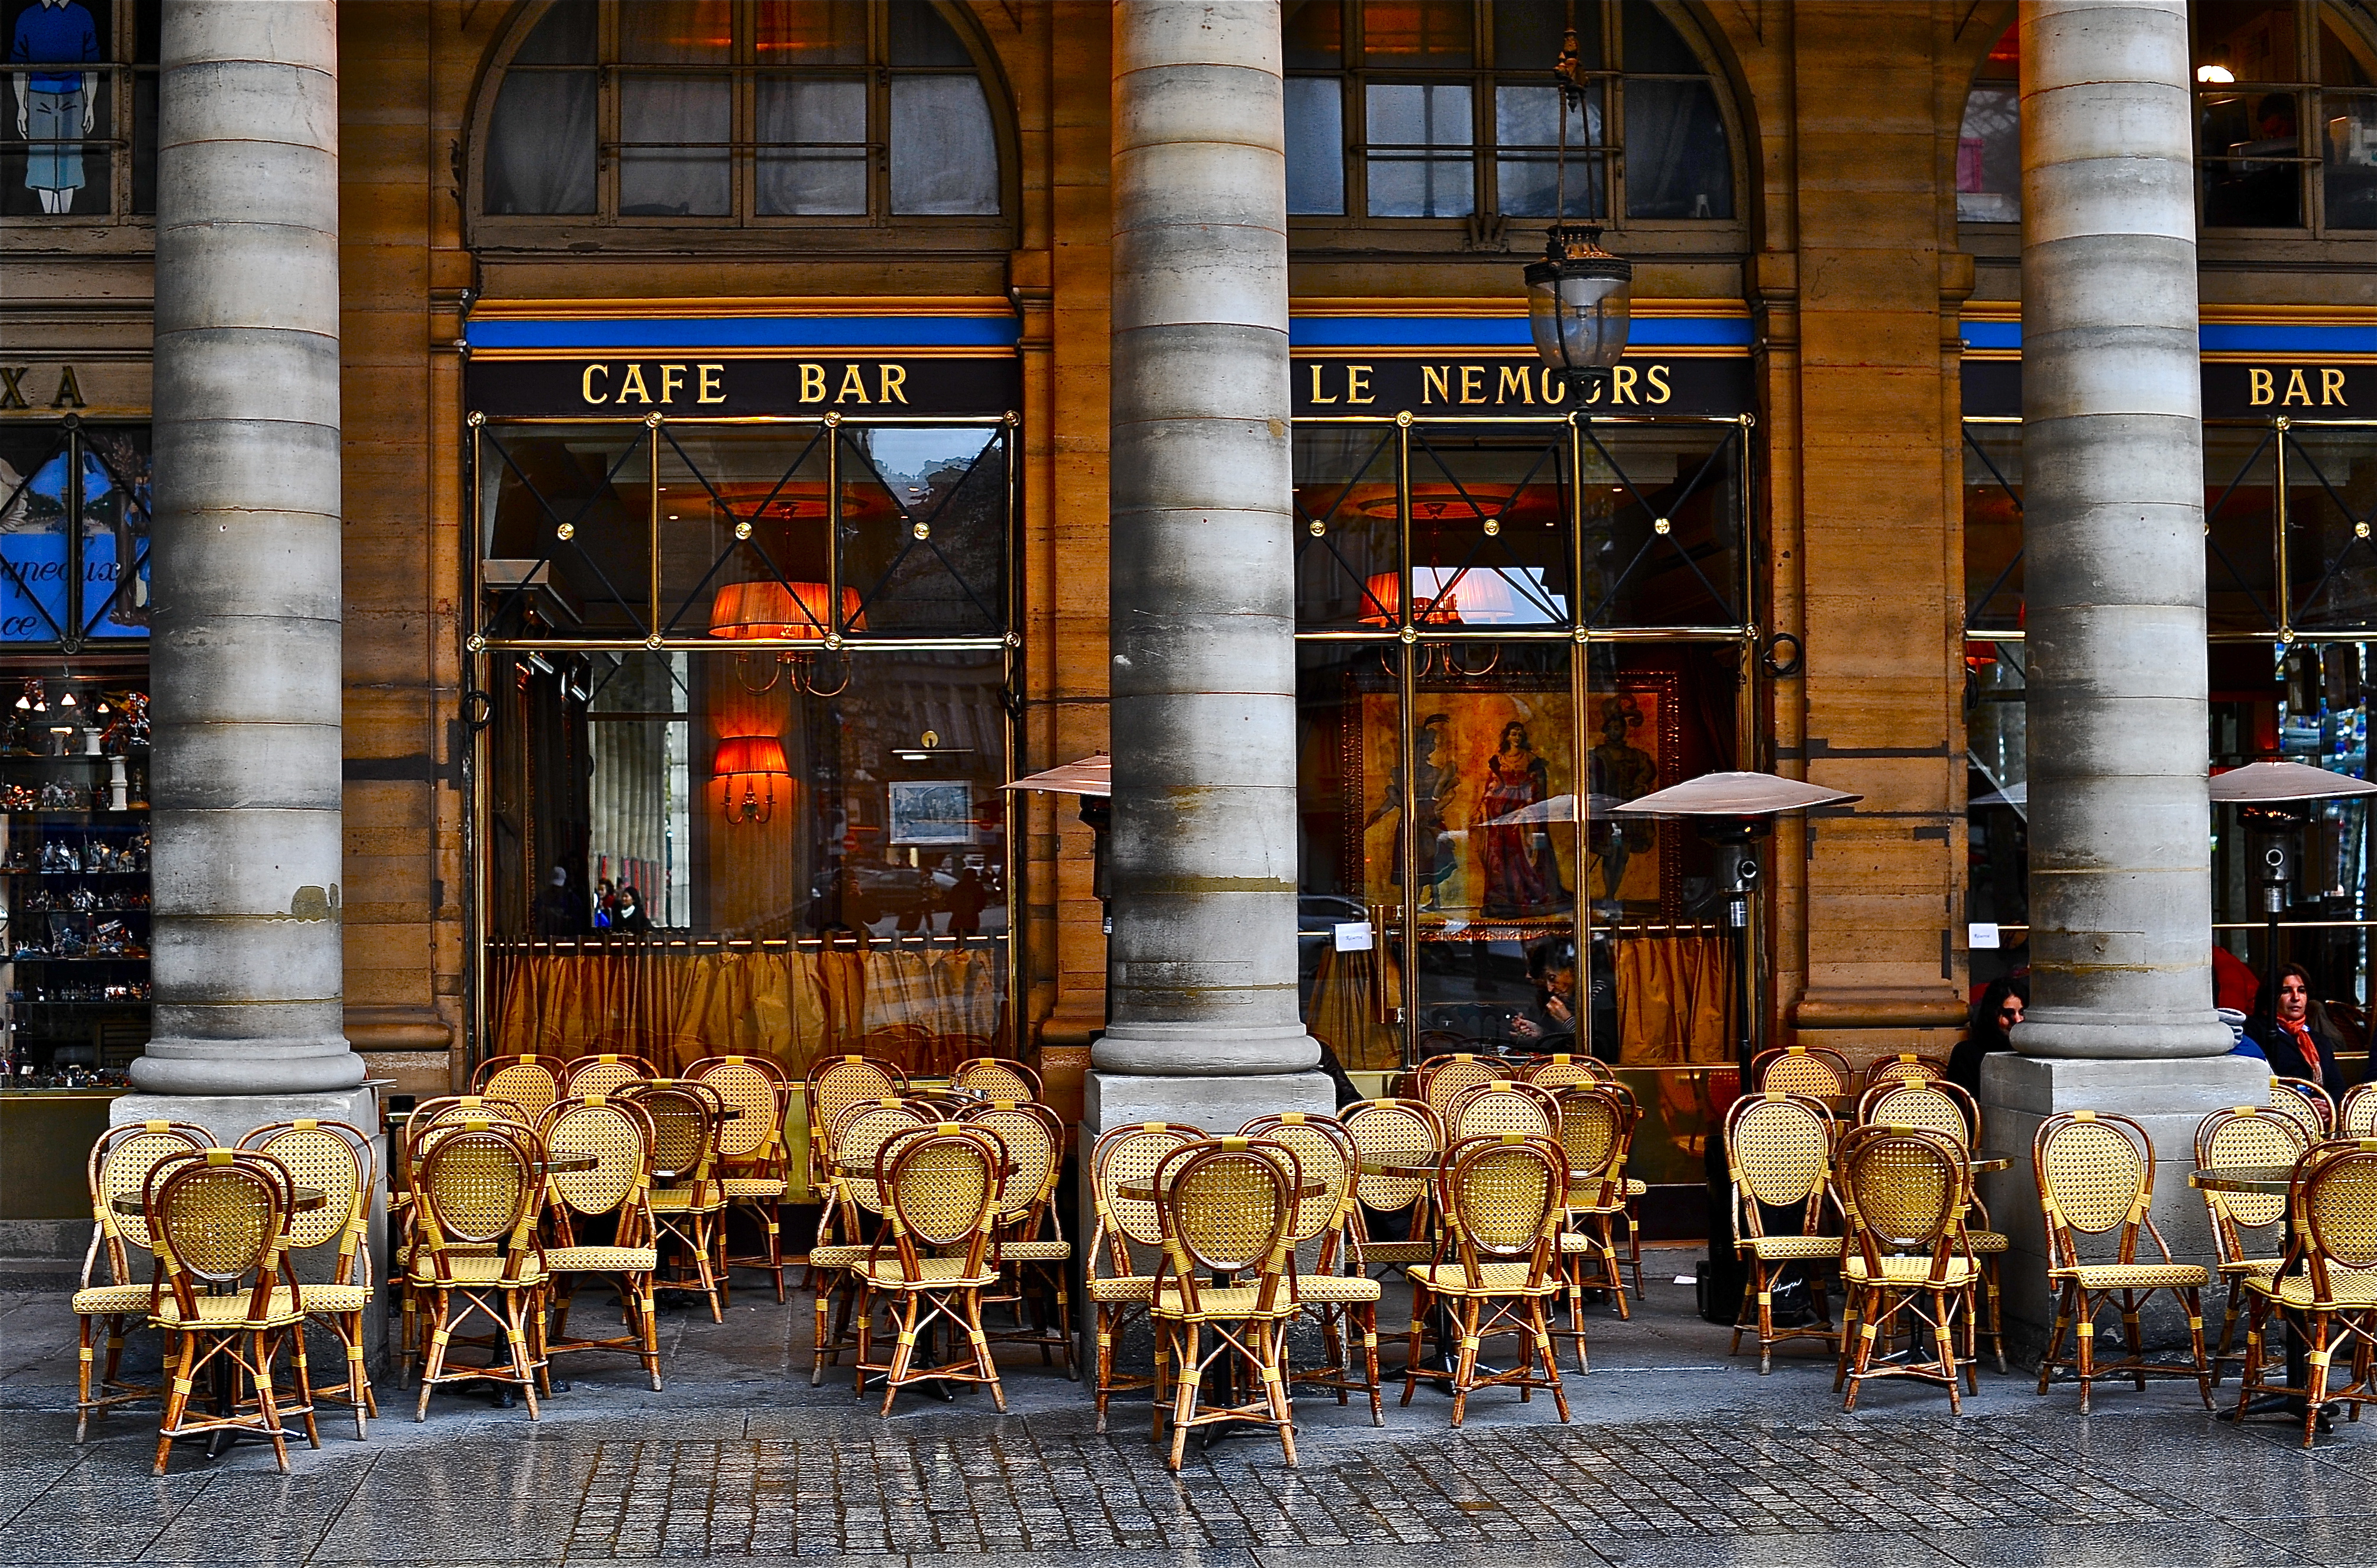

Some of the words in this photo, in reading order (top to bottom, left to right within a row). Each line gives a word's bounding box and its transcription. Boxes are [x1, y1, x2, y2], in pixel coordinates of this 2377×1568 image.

[582, 363, 727, 404] CAFE
[798, 363, 909, 404] BAR
[1309, 364, 1376, 404] LE
[2248, 368, 2349, 407] BAR
